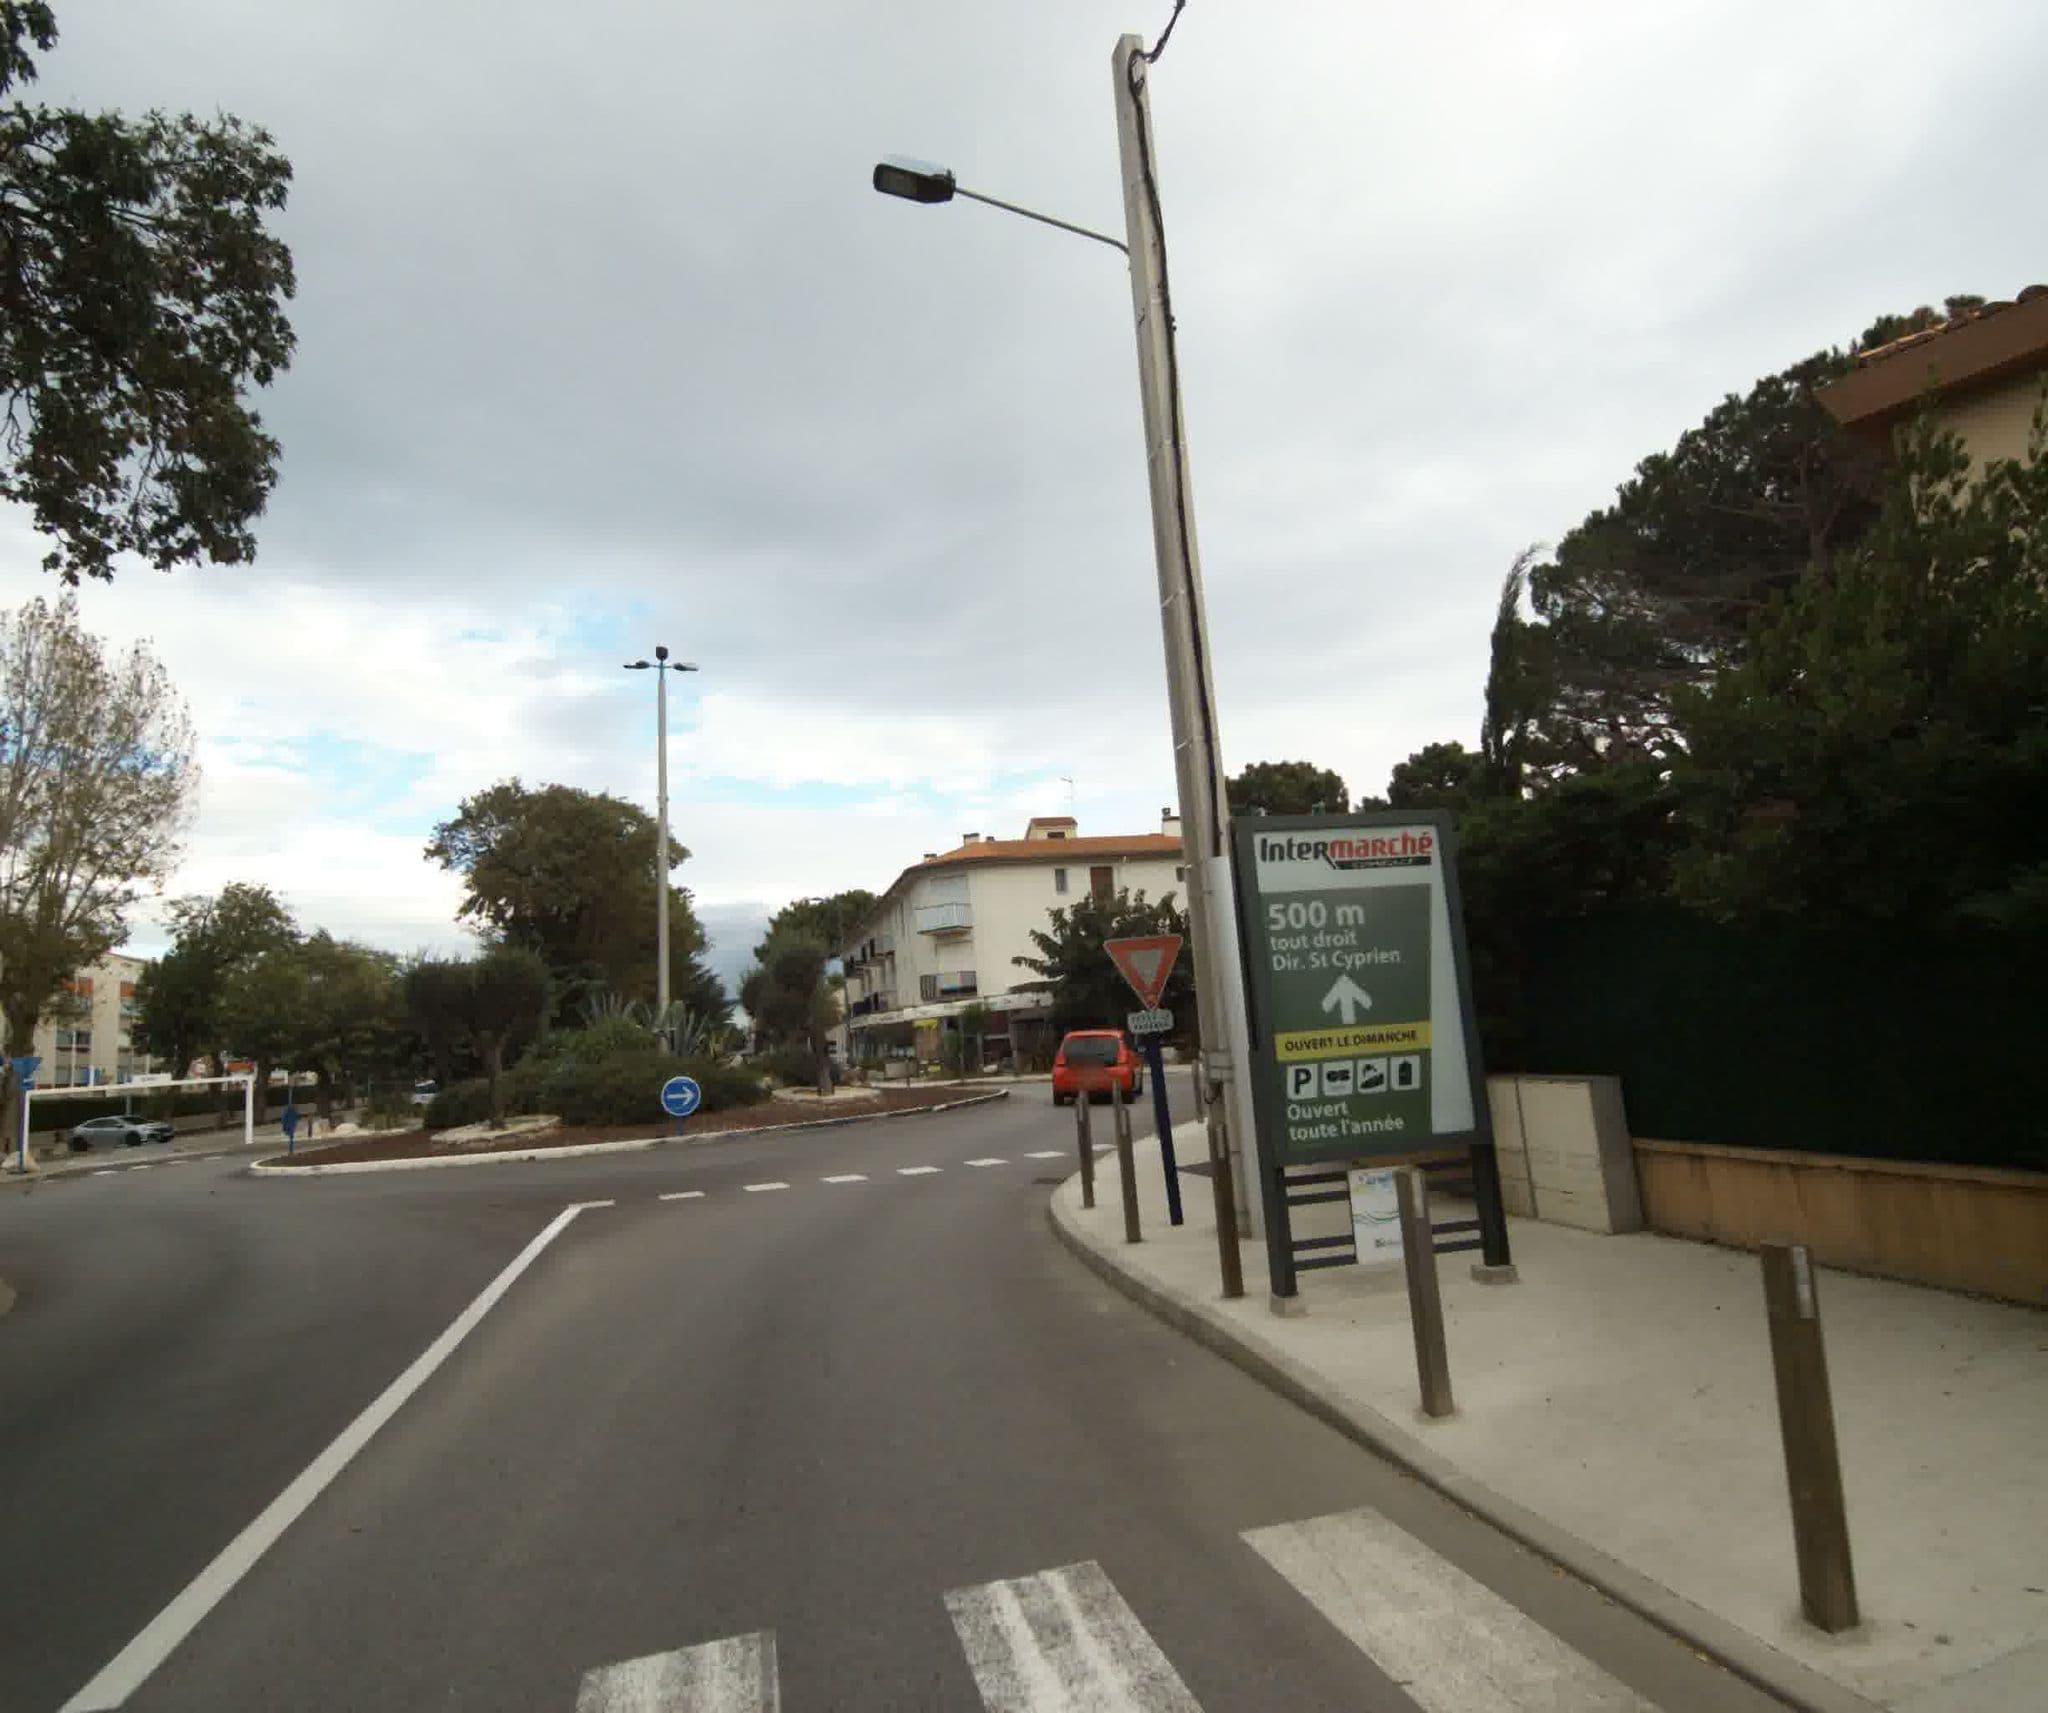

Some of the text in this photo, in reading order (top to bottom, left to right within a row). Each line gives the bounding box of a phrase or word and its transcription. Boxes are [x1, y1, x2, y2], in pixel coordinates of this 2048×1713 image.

[1268, 901, 1366, 930] 500 m
[1271, 930, 1358, 950] tout droit
[1273, 948, 1401, 972] Dir. St Cyprien
[1285, 1029, 1418, 1051] OUVERT LE DIMANCHE
[1294, 1068, 1312, 1094] P
[1287, 1101, 1349, 1120] Ouvert
[1290, 1114, 1405, 1140] toute l'année
